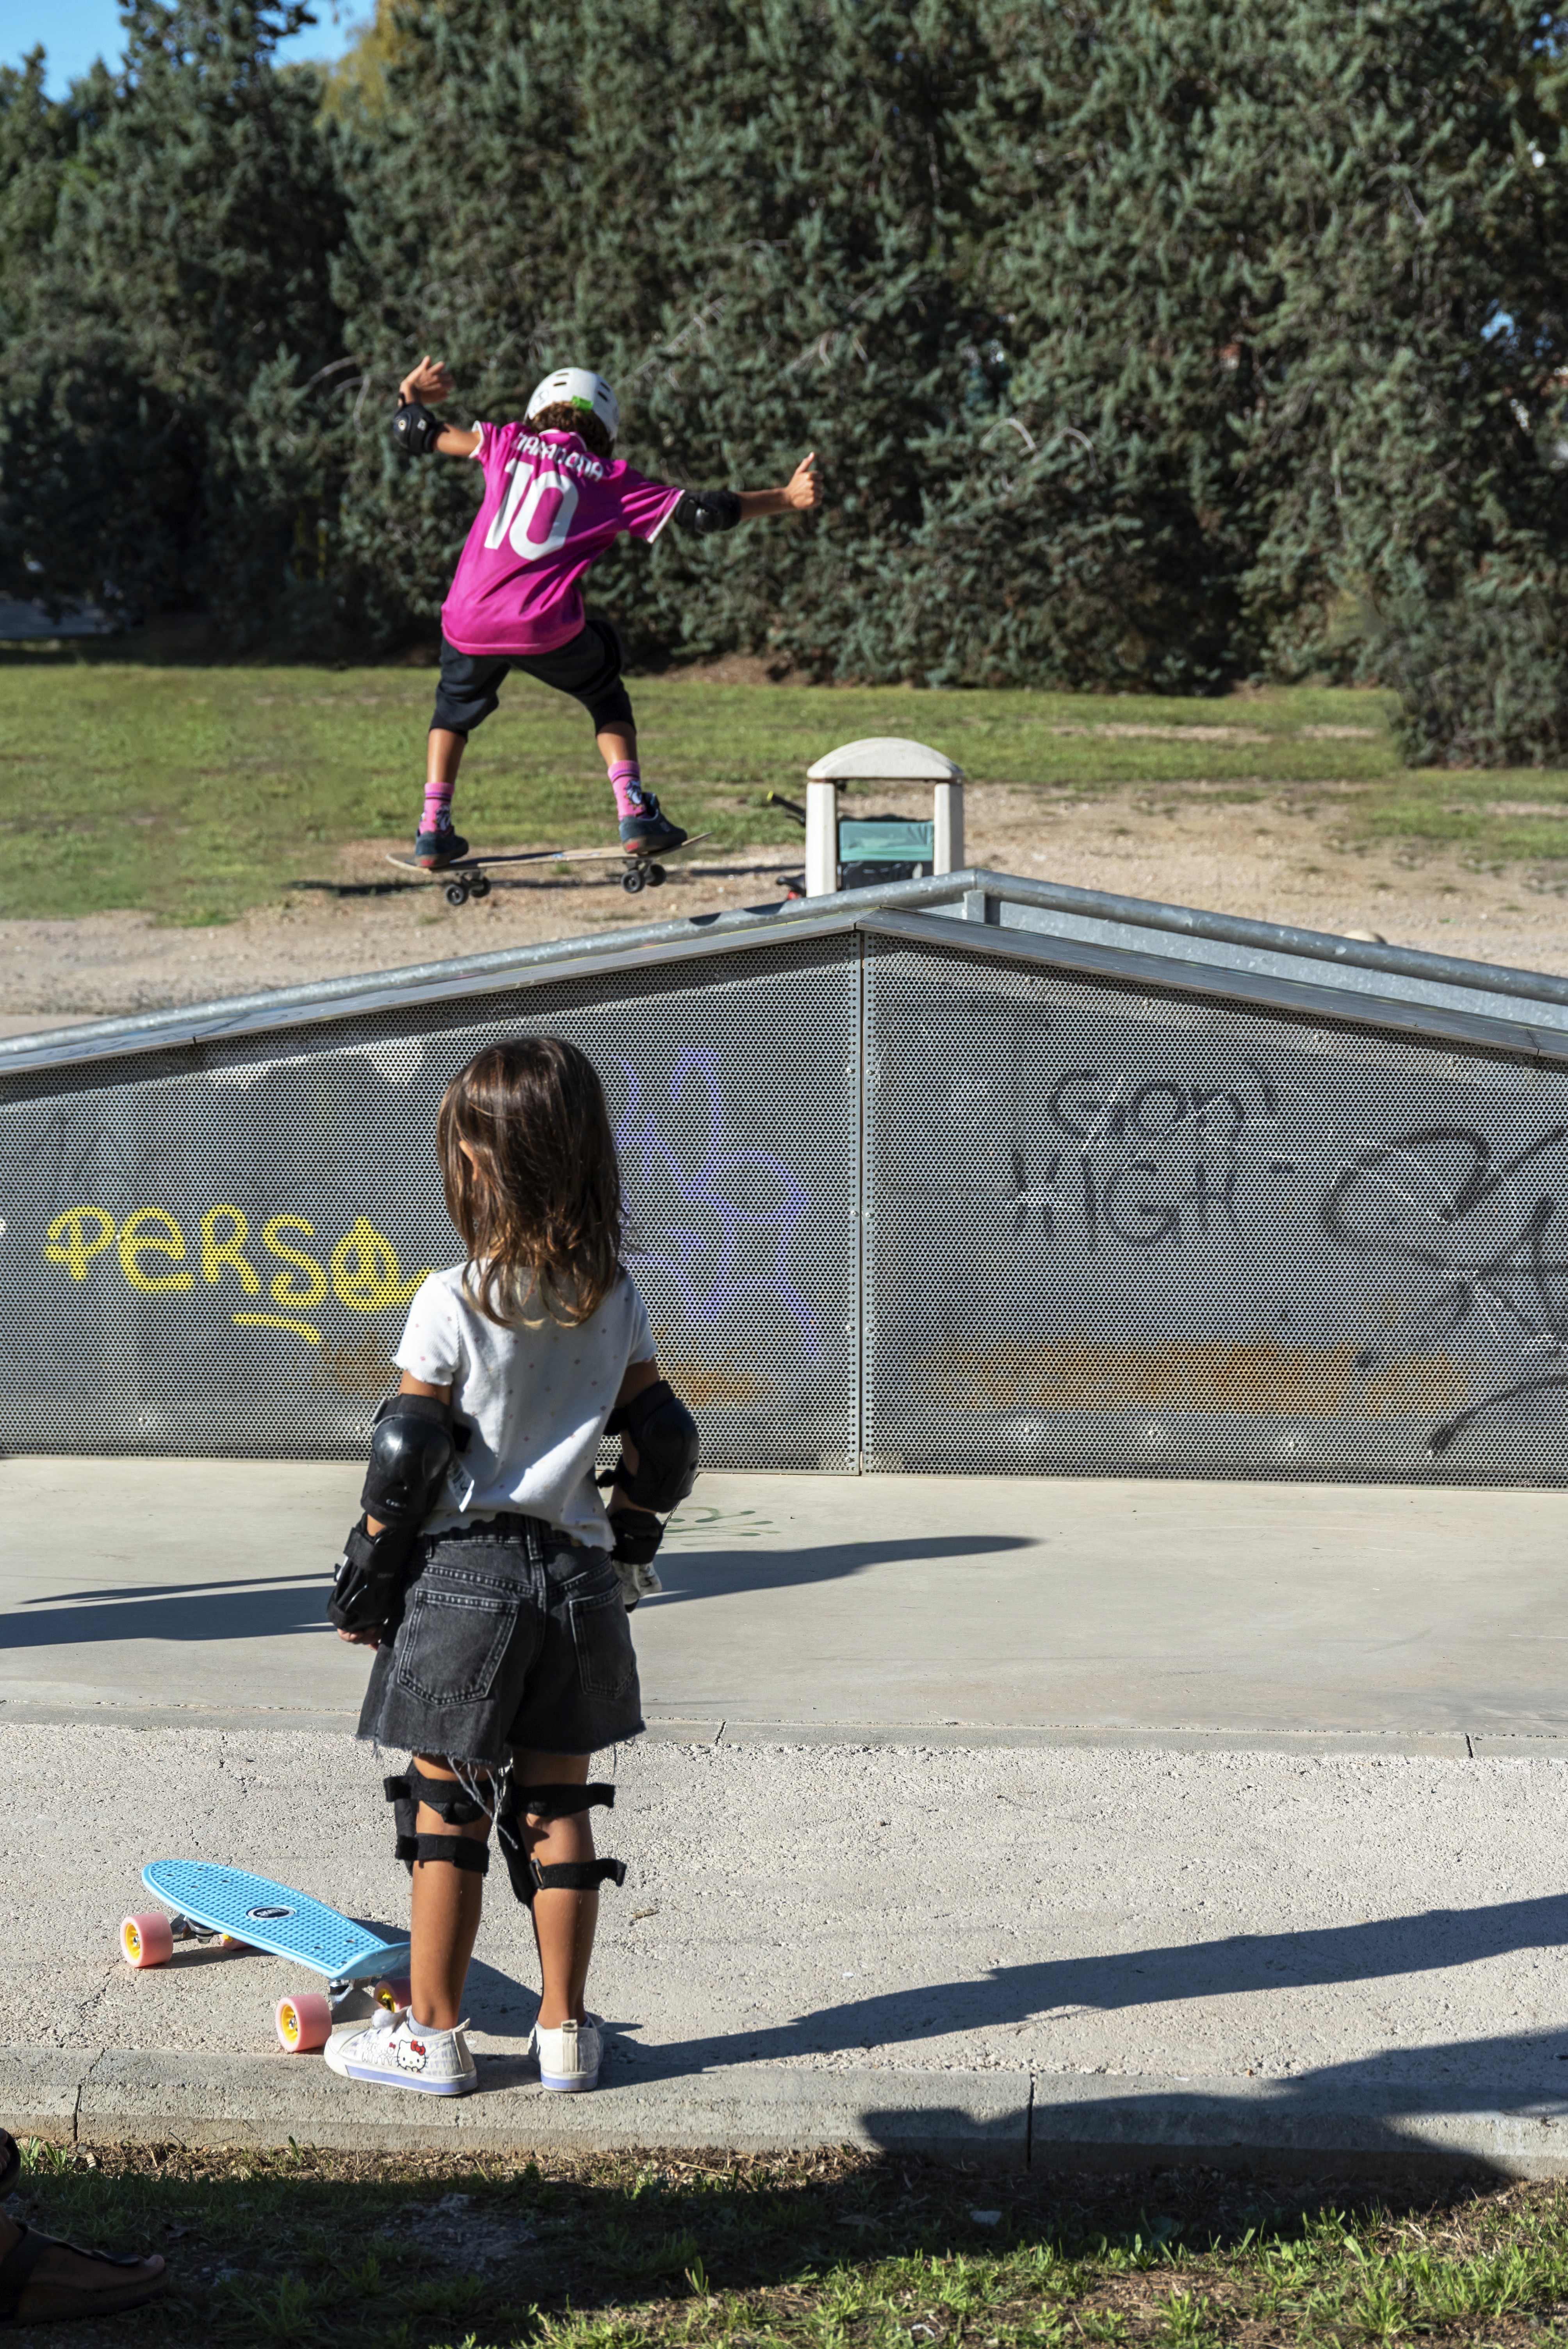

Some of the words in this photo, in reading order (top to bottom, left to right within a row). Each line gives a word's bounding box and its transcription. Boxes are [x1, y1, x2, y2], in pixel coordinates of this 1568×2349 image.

[484, 458, 579, 561] 10
[364, 2041, 395, 2055] HELLO
[362, 2051, 394, 2066] KITTY
